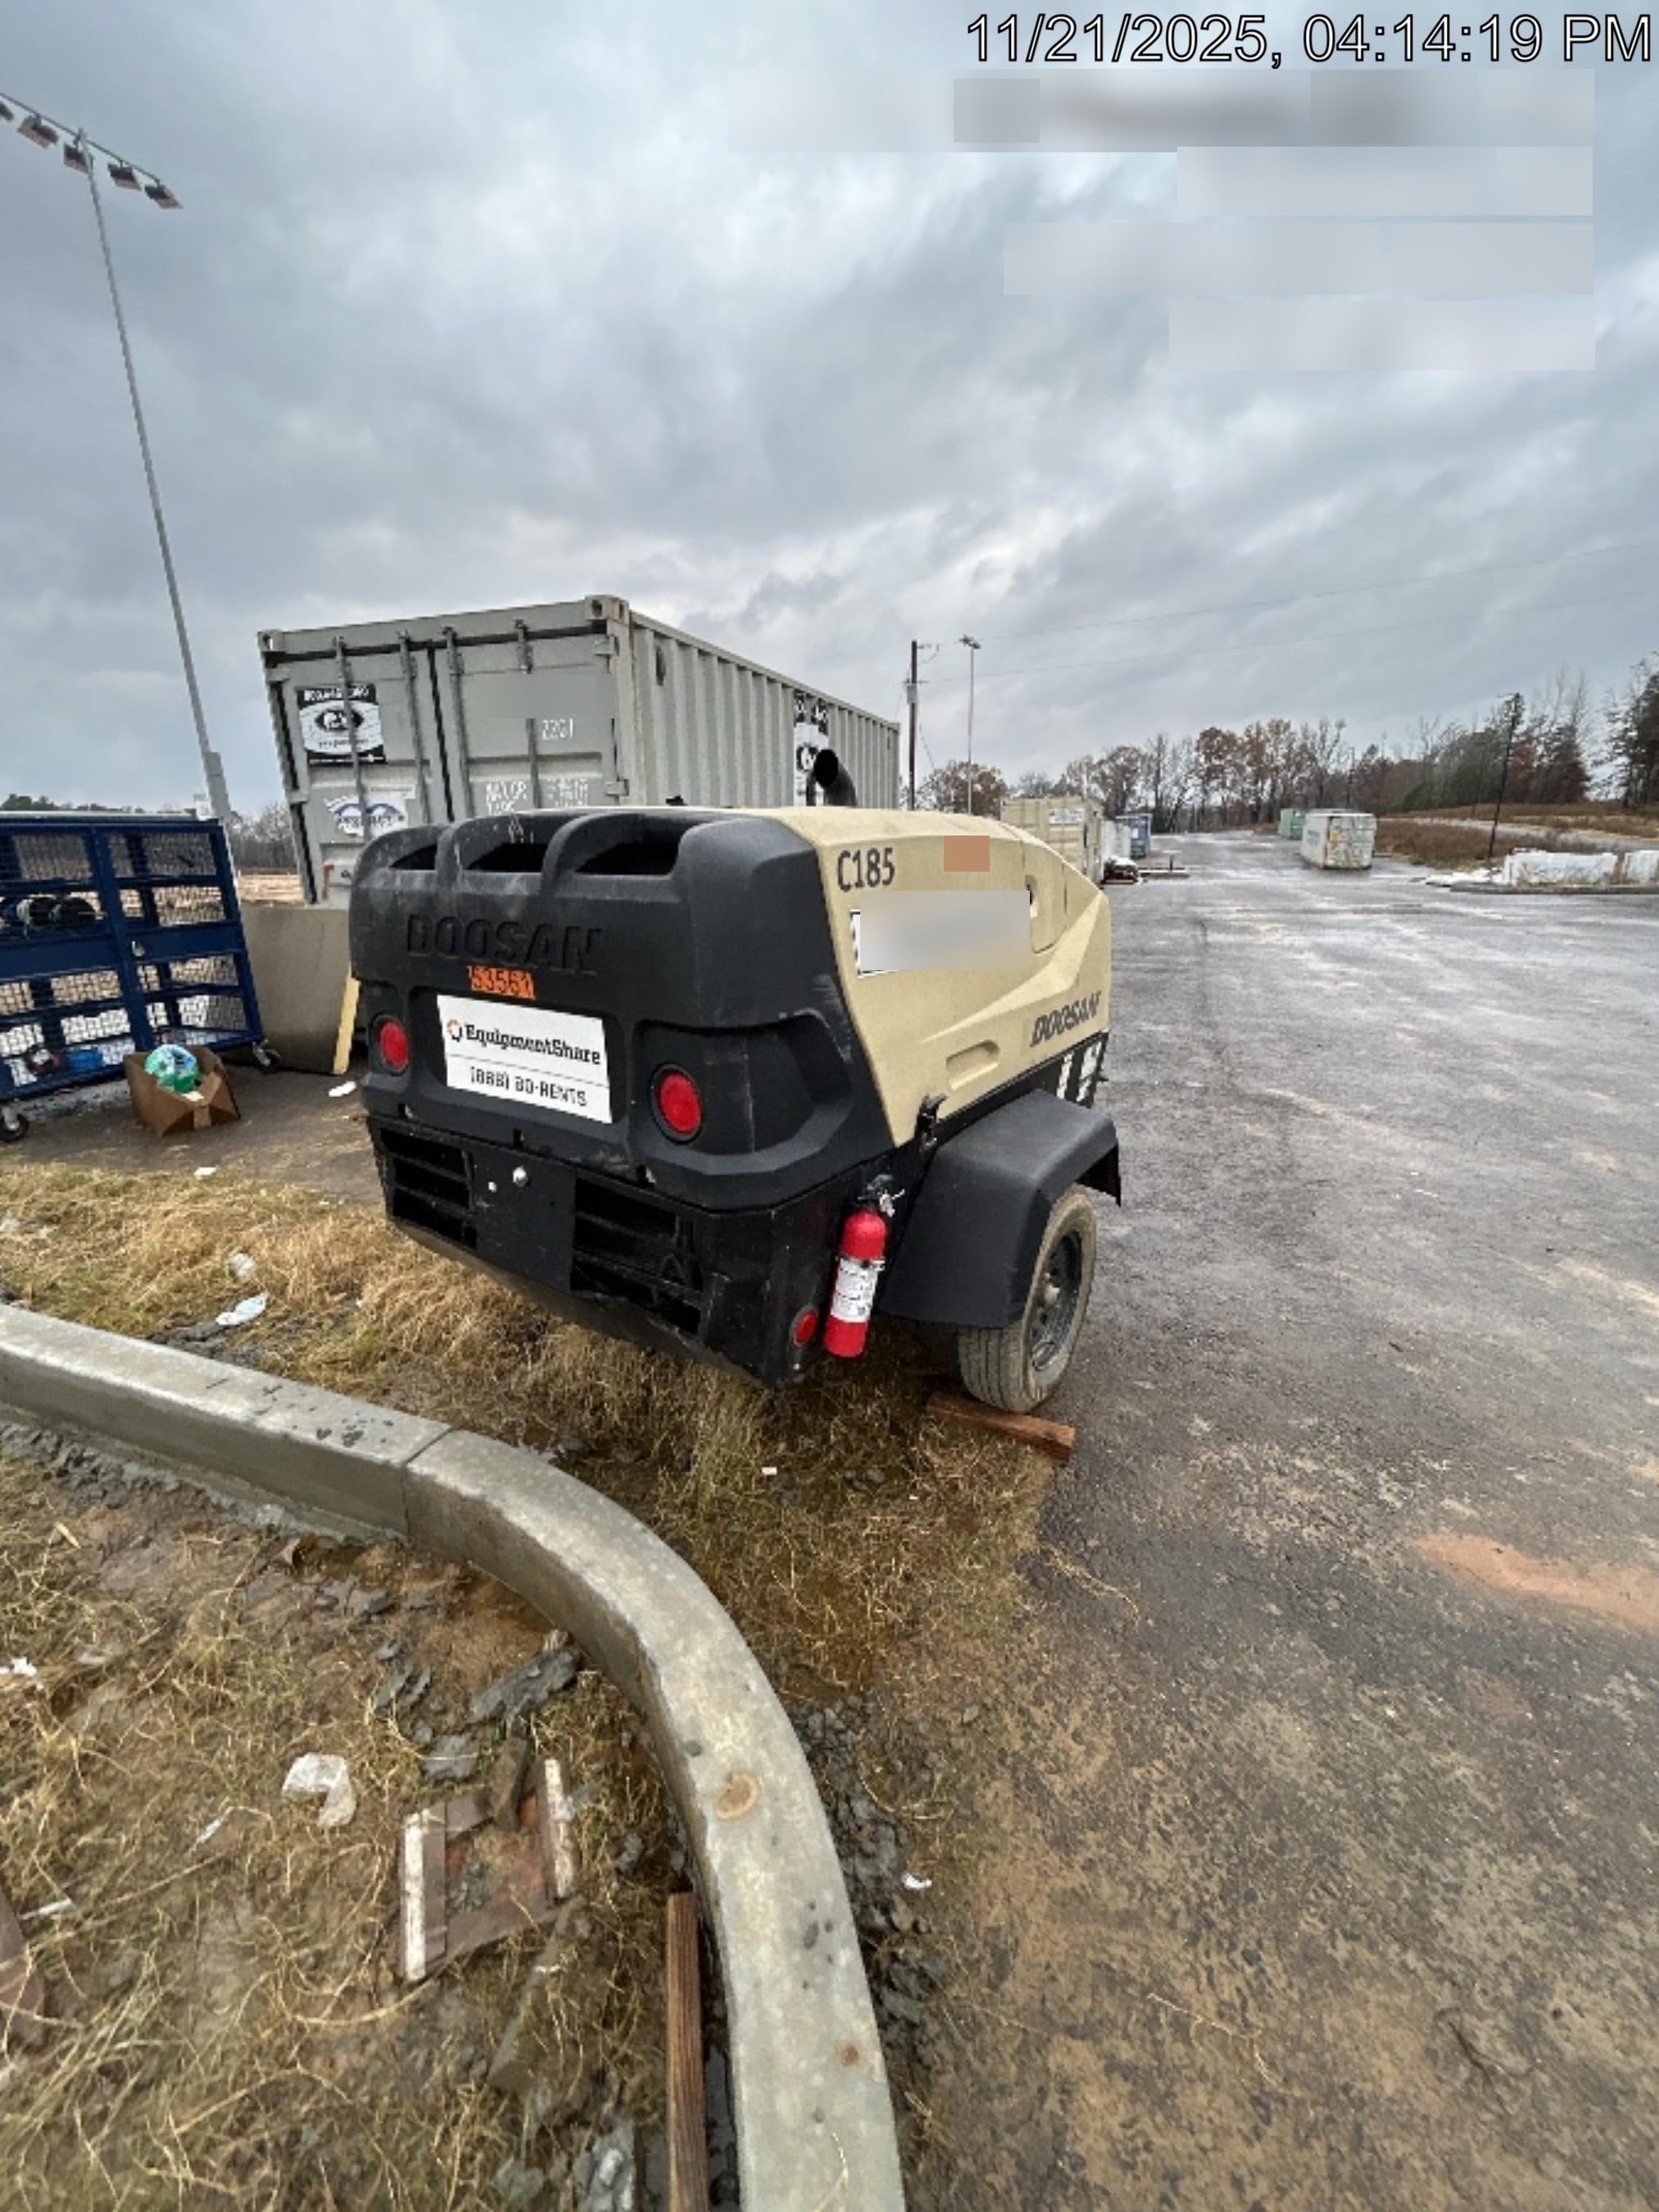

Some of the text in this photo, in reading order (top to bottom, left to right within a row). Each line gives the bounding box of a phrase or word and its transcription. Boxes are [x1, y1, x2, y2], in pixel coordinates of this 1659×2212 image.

[838, 847, 895, 892] C185
[407, 913, 603, 977] DOOSAN
[1030, 990, 1101, 1048] DOOSAN
[465, 1024, 601, 1065] EquipmentShare
[470, 1066, 510, 1090] (888)
